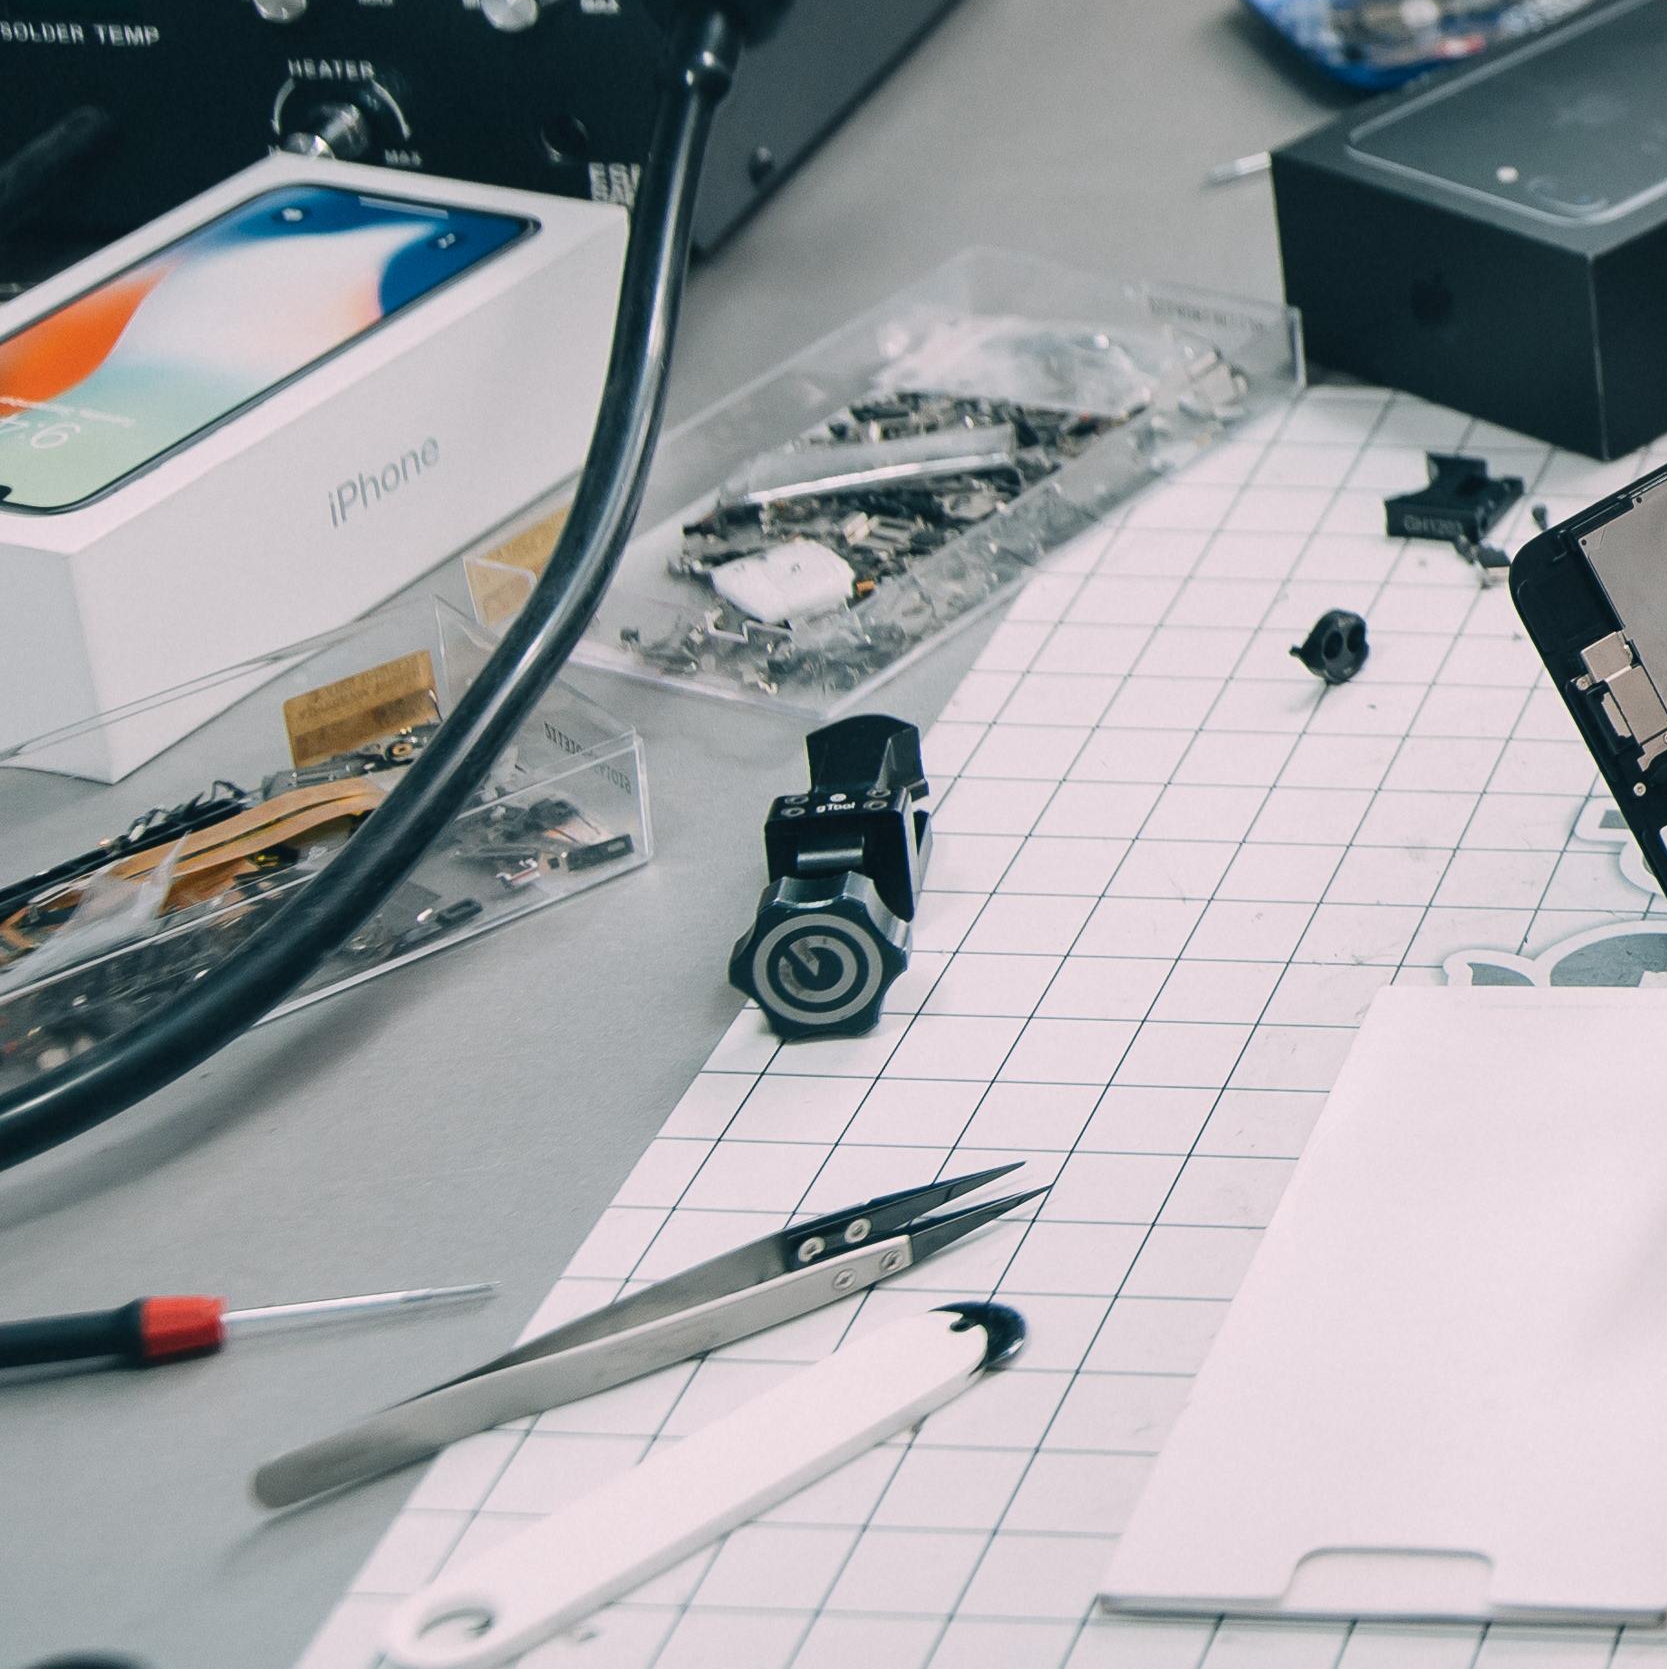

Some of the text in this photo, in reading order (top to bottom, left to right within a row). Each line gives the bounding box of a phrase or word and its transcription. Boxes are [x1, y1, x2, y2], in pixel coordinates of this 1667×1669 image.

[0, 20, 161, 47] SOLDER TEMP
[288, 58, 377, 80] HEATER
[327, 435, 440, 529] iPhone
[816, 801, 856, 814] gTool
